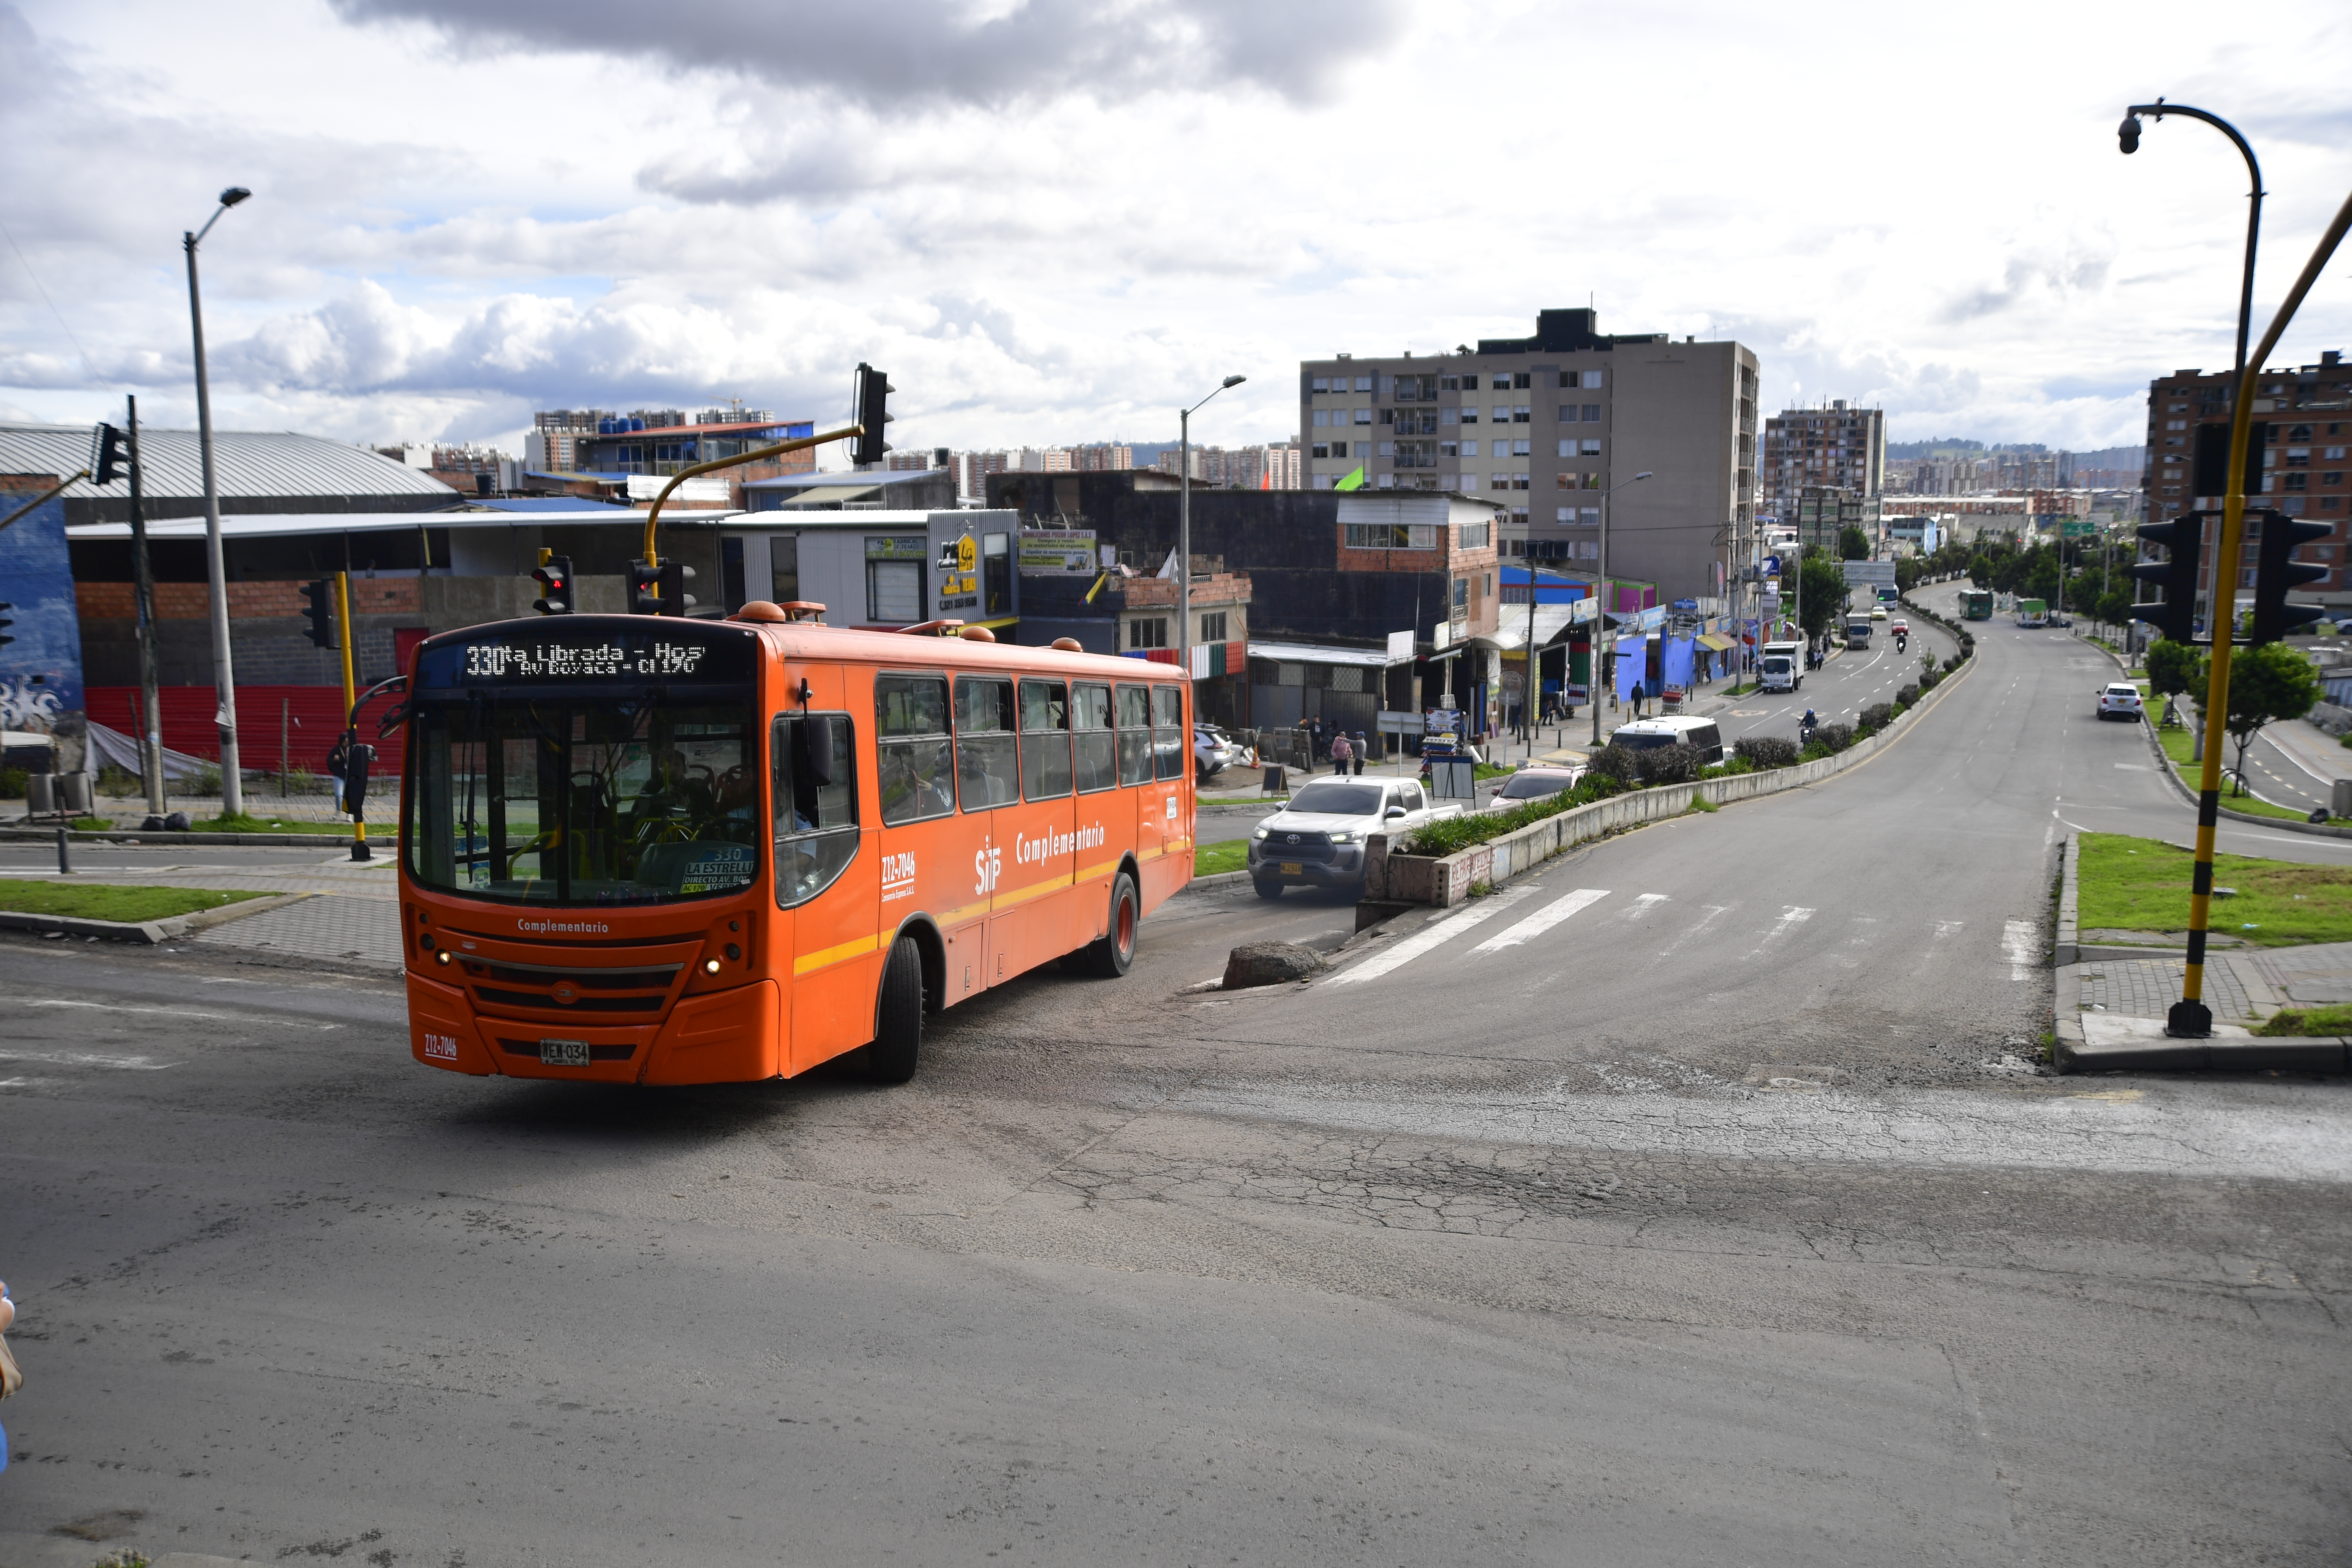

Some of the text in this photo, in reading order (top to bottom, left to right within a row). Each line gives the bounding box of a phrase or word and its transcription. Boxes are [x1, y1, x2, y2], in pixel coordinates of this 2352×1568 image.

[467, 646, 505, 676] 330
[536, 644, 624, 662] Librada
[714, 848, 742, 861] 330
[1016, 820, 1104, 866] Complementario
[686, 861, 754, 874] LA ESTRELLI
[882, 851, 915, 883] Z12-7046
[517, 918, 608, 934] Complementario
[425, 1033, 457, 1057] Z12-7046
